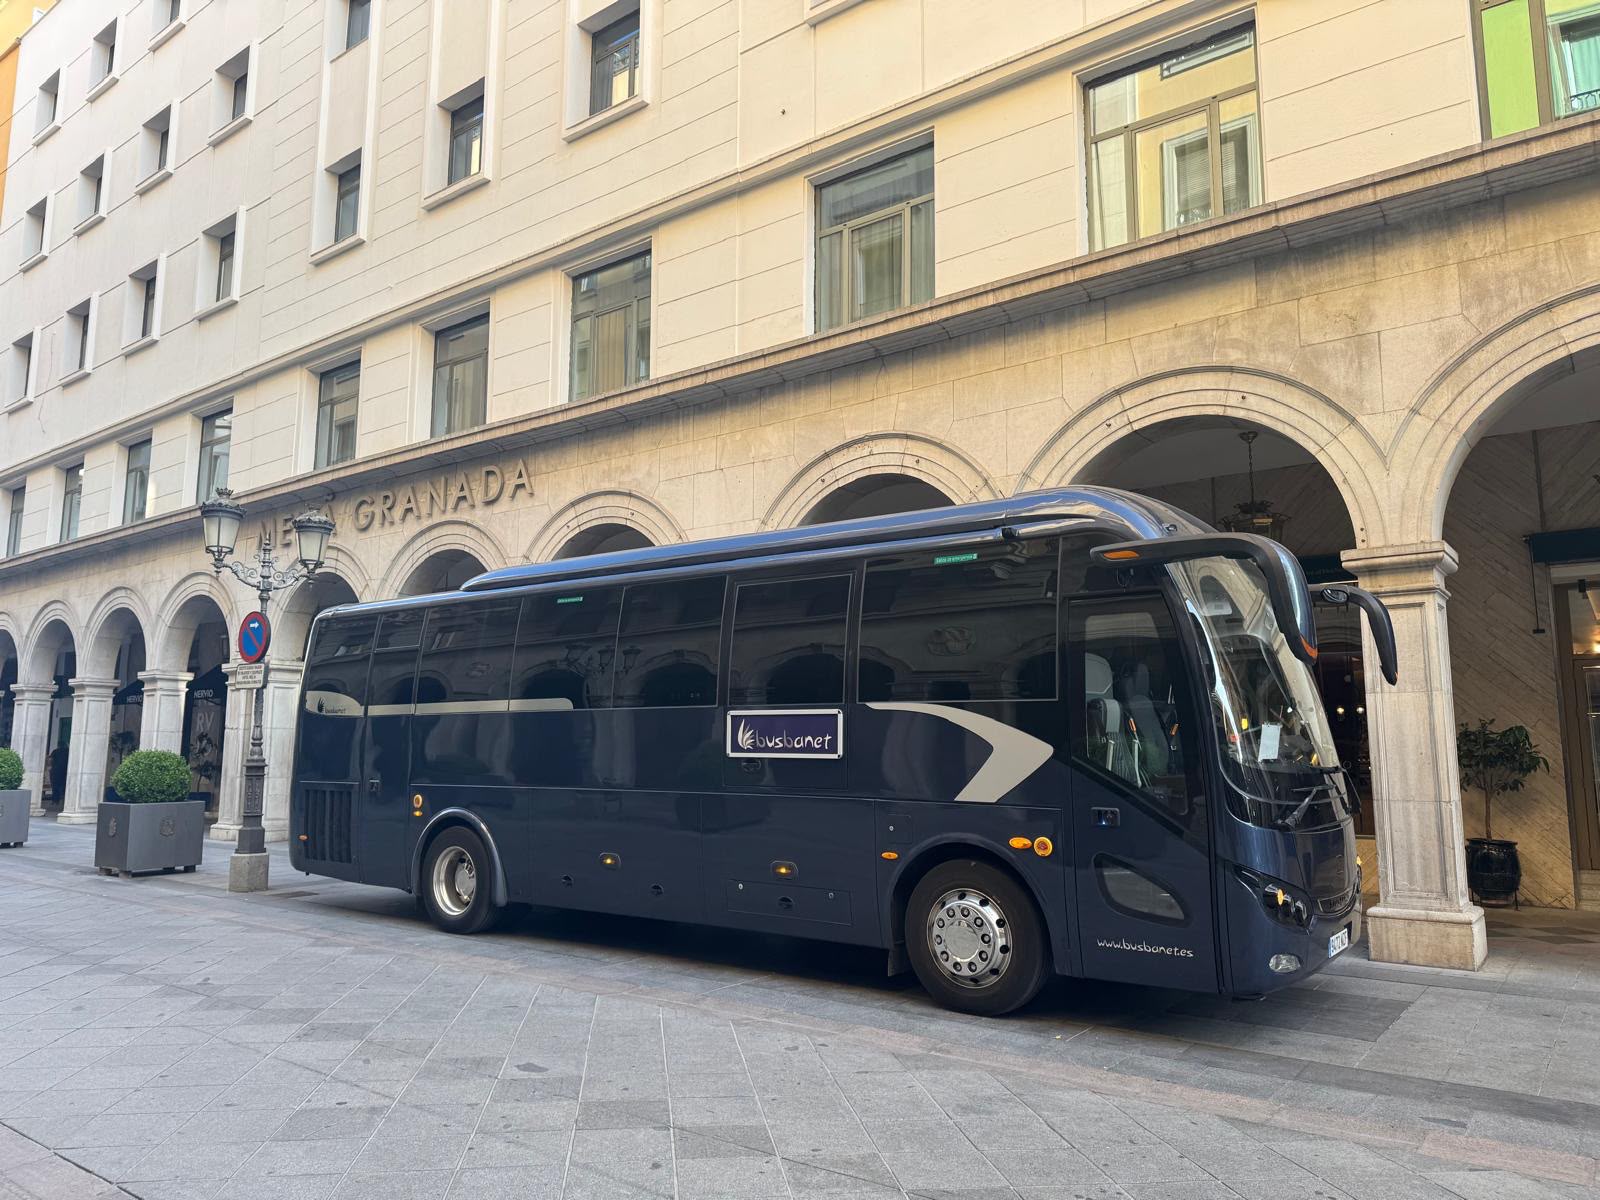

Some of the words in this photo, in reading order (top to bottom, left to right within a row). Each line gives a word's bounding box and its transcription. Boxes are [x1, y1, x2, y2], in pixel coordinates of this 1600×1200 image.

[352, 458, 535, 532] GRANADA
[194, 689, 214, 699] NERVIO
[756, 729, 833, 750] busbanet
[1096, 937, 1195, 958] www.busbanet.es
